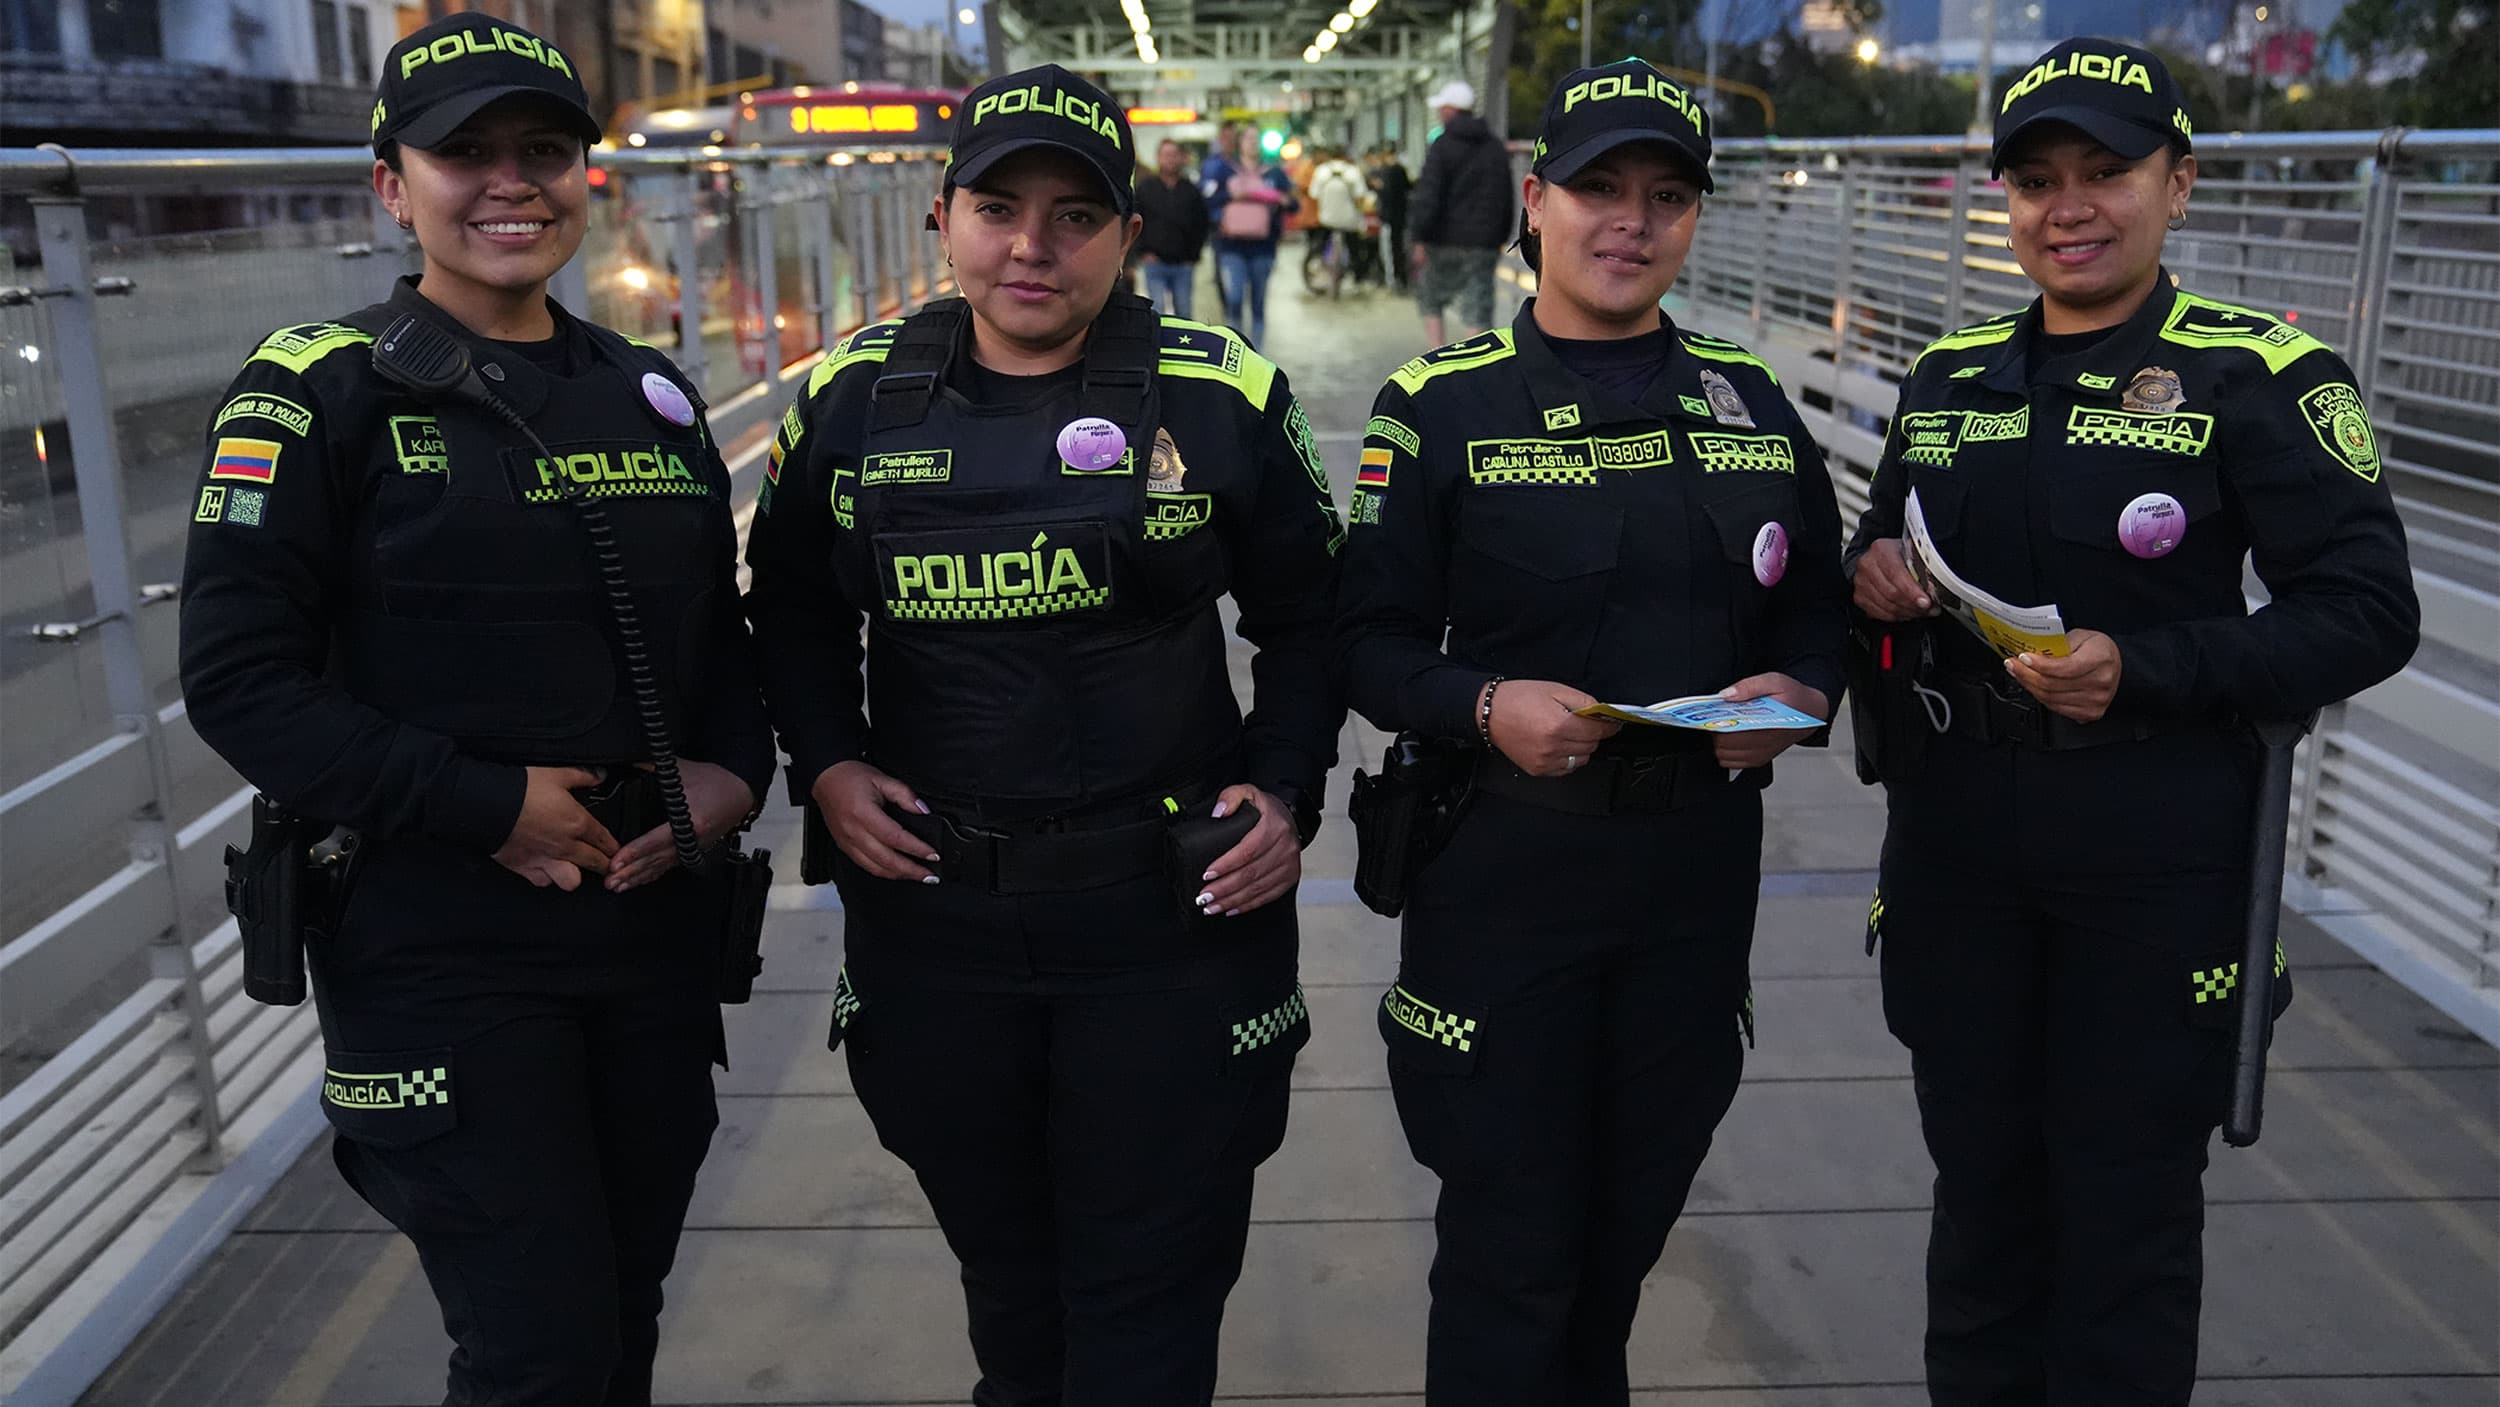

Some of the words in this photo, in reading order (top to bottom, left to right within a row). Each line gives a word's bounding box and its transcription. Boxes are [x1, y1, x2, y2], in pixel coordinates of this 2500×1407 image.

[401, 27, 573, 80] POLICÍA
[2001, 52, 2153, 115] POLICÍA
[973, 85, 1121, 150] POLICÍA
[1564, 74, 1702, 137] POLICÍA
[256, 401, 274, 414] SER
[272, 405, 307, 431] POLICÍA
[2083, 415, 2194, 439] POLICÍA
[1500, 444, 1563, 455] Patrullero
[1601, 439, 1663, 463] 038097
[1703, 440, 1787, 458] POLICÍA
[535, 444, 693, 486] POLICÍA
[879, 455, 934, 468] Patrullero
[903, 467, 946, 478] MURILLO
[1482, 454, 1530, 470] CATALINA
[1533, 454, 1584, 468] CASTILLO
[2138, 502, 2173, 514] Patrulla
[894, 531, 1090, 599] POLICÍA
